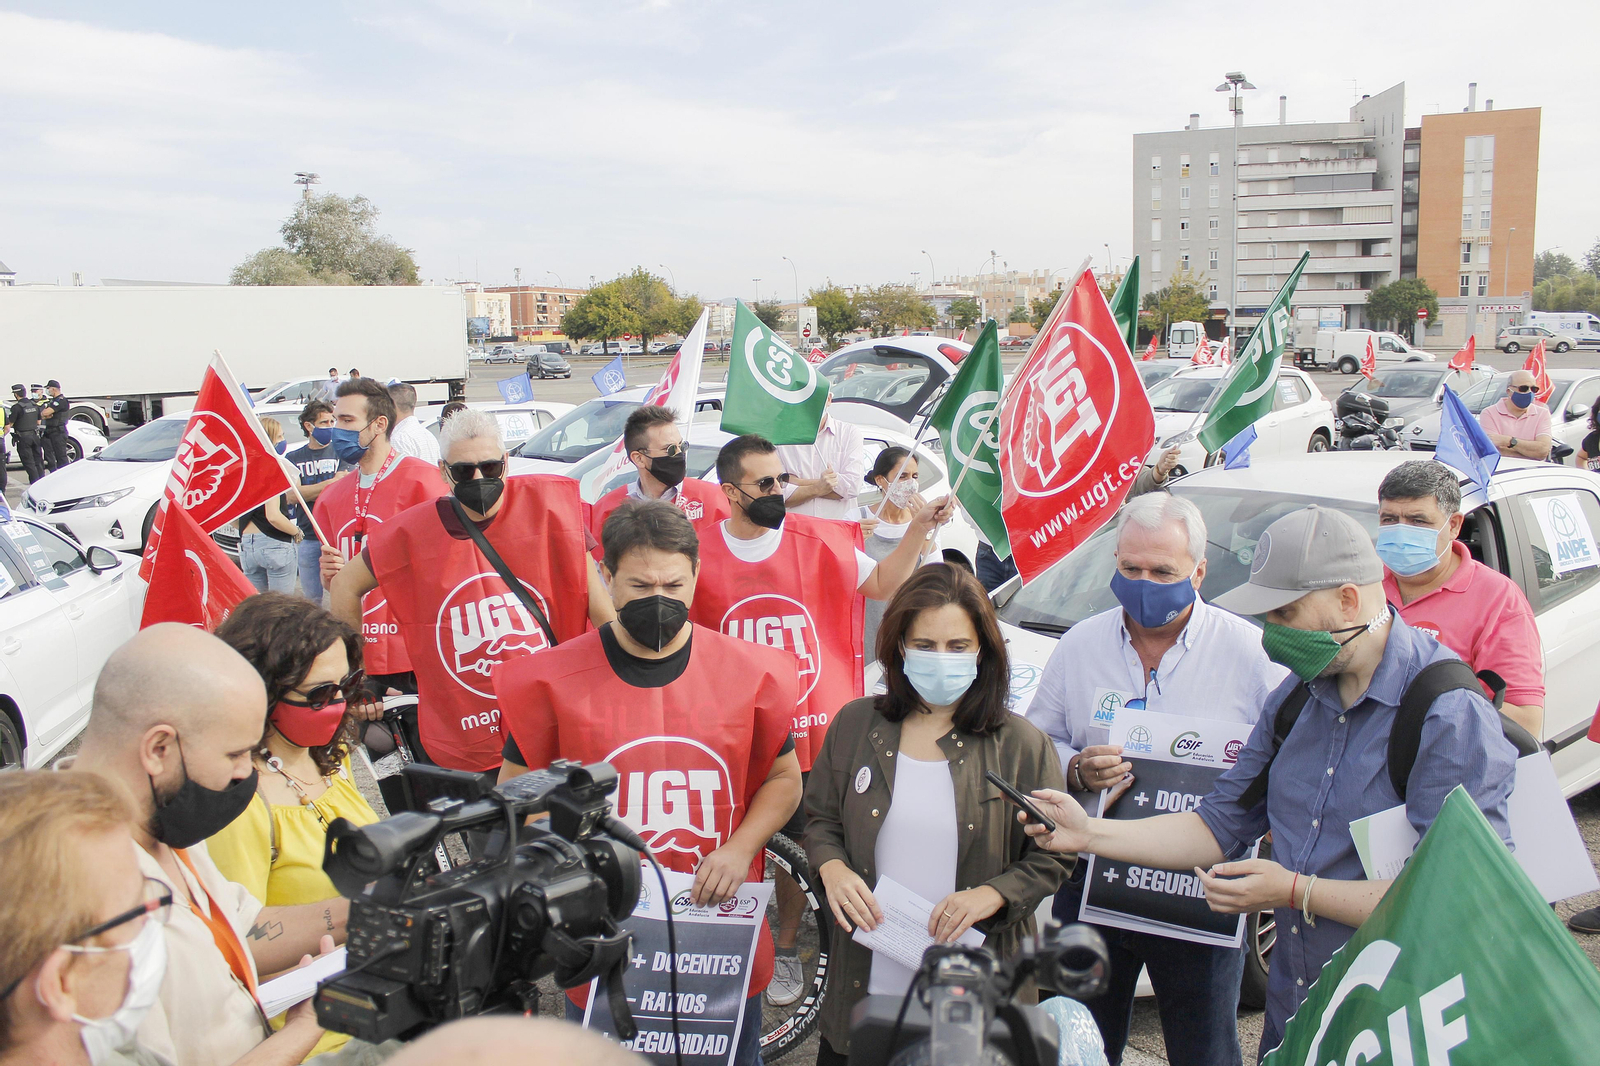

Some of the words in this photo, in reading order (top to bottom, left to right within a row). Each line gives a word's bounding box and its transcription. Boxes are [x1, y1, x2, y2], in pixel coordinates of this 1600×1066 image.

[506, 428, 530, 439] ANPE
[297, 459, 340, 477] TOMY
[1029, 455, 1143, 549] www.ugt.es
[1556, 538, 1591, 561] ANPE
[450, 591, 537, 654] UGT
[728, 614, 807, 659] UGT
[1123, 741, 1153, 752] ANPE
[1176, 738, 1203, 751] CSIF
[606, 770, 721, 837] UGT
[637, 900, 650, 910] PE
[652, 951, 742, 975] DOCENTES
[640, 990, 707, 1014] RATIOS
